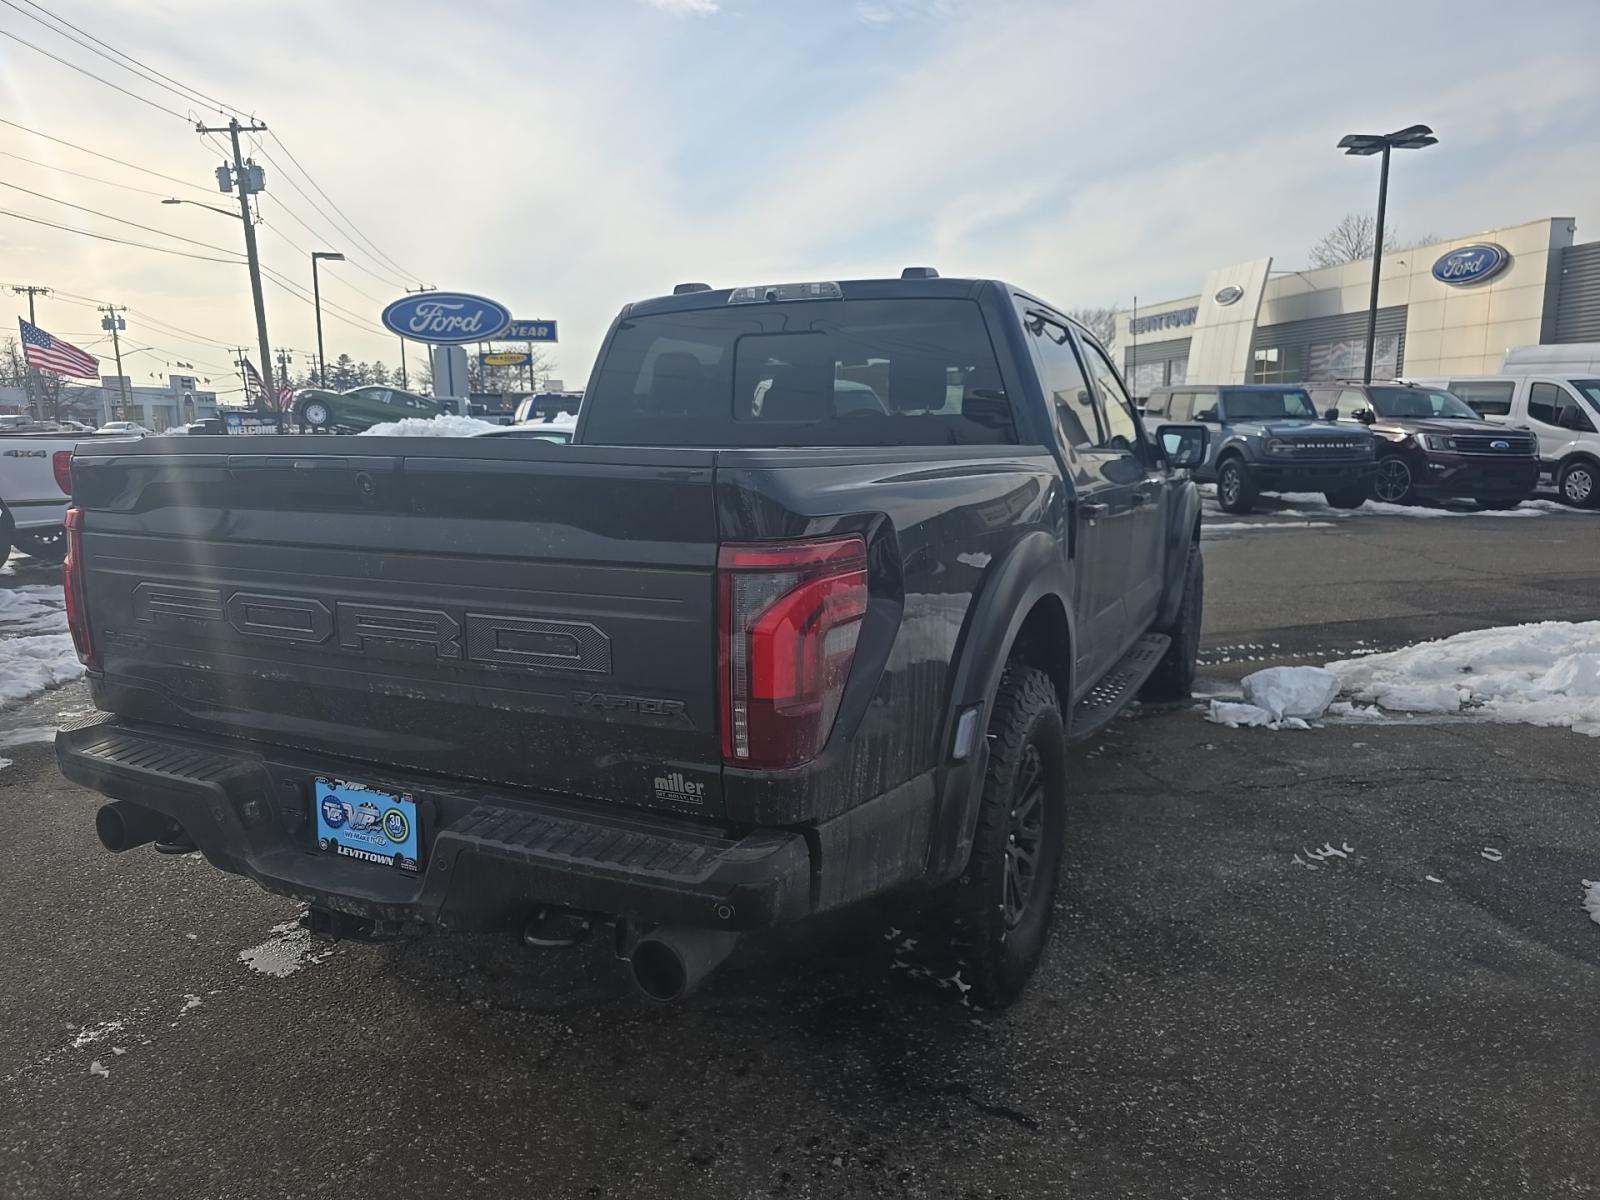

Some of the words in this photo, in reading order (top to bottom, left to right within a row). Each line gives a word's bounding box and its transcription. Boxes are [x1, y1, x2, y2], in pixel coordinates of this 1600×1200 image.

[1443, 252, 1485, 277] Ford
[409, 302, 483, 332] Ford
[131, 582, 613, 673] FORD
[654, 772, 704, 795] miller
[337, 846, 394, 866] LEVITTOWN
